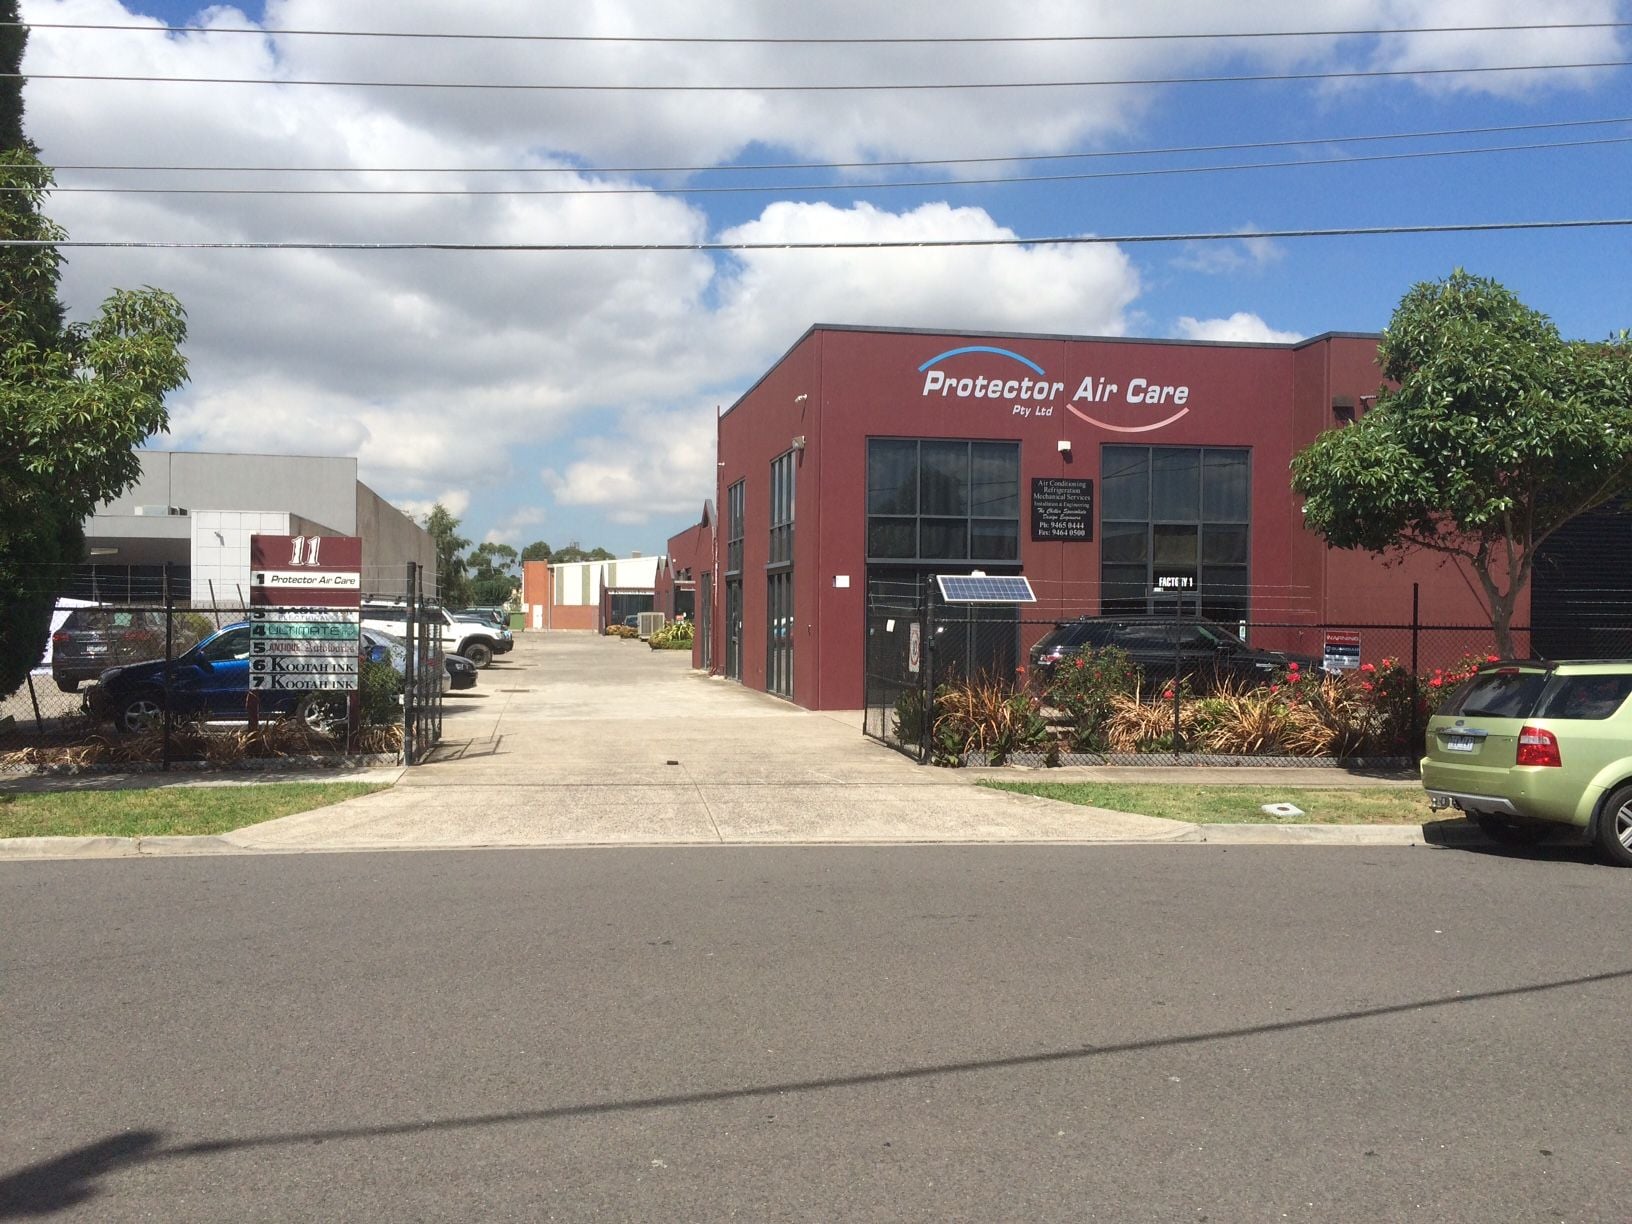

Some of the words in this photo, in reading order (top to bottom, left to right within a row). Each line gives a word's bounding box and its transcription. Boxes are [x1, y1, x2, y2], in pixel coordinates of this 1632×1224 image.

[922, 370, 1064, 400] Protector
[1072, 376, 1118, 402] Air
[1126, 378, 1189, 404] Care
[1012, 404, 1031, 418] Pty
[1035, 405, 1053, 416] Ltd
[1049, 480, 1087, 489] Conditioning
[288, 535, 321, 566] 11
[256, 573, 265, 585] 1
[271, 575, 317, 584] Protector
[318, 576, 333, 584] Air
[334, 576, 356, 585] Care
[252, 623, 266, 636] 4
[269, 626, 340, 636] ULTIMATE
[253, 642, 266, 653] 5
[253, 659, 266, 671] 6
[271, 656, 328, 672] KOOTAH
[332, 663, 354, 672] INK
[253, 676, 265, 688] 7
[271, 674, 328, 689] KOOTAH
[332, 680, 353, 689] INK
